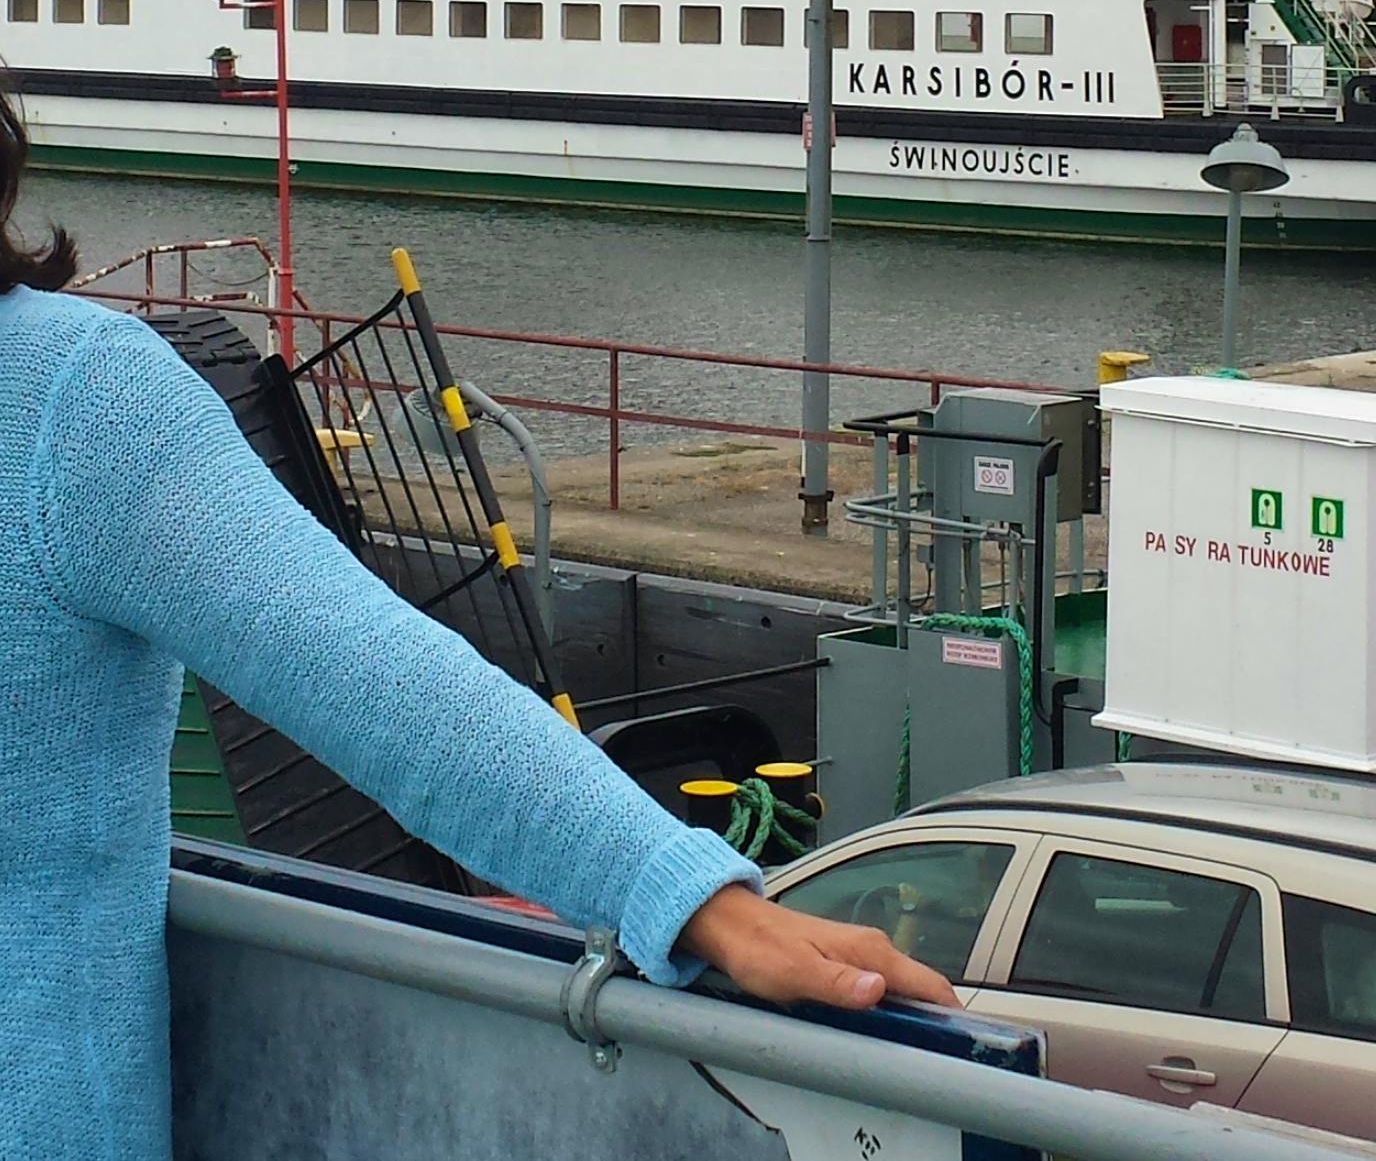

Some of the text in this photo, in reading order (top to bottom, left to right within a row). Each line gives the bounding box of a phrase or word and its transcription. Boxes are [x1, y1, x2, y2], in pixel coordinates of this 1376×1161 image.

[849, 60, 1114, 104] KARSIBÓR-III
[889, 140, 1070, 178] ŚWINOUJŚCIE
[1264, 531, 1272, 546] 5
[1317, 538, 1334, 553] 28
